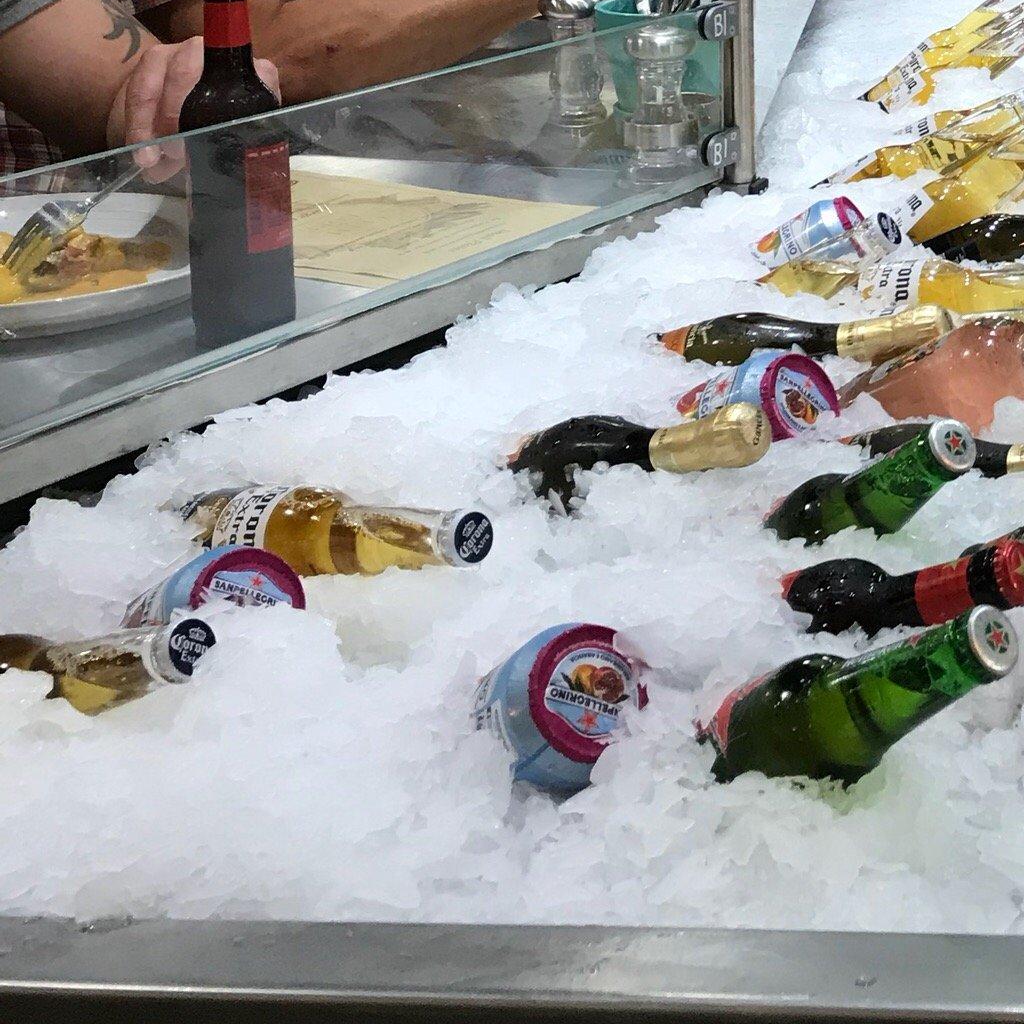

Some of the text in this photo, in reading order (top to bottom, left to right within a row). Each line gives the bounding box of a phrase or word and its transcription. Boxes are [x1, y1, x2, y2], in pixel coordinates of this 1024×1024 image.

[780, 374, 827, 412] SANPELLEGRIN
[229, 495, 264, 546] Extra
[244, 485, 290, 546] Coron
[460, 518, 489, 558] Corona
[171, 634, 208, 654] Coron
[551, 688, 618, 716] PELLEGRINO
